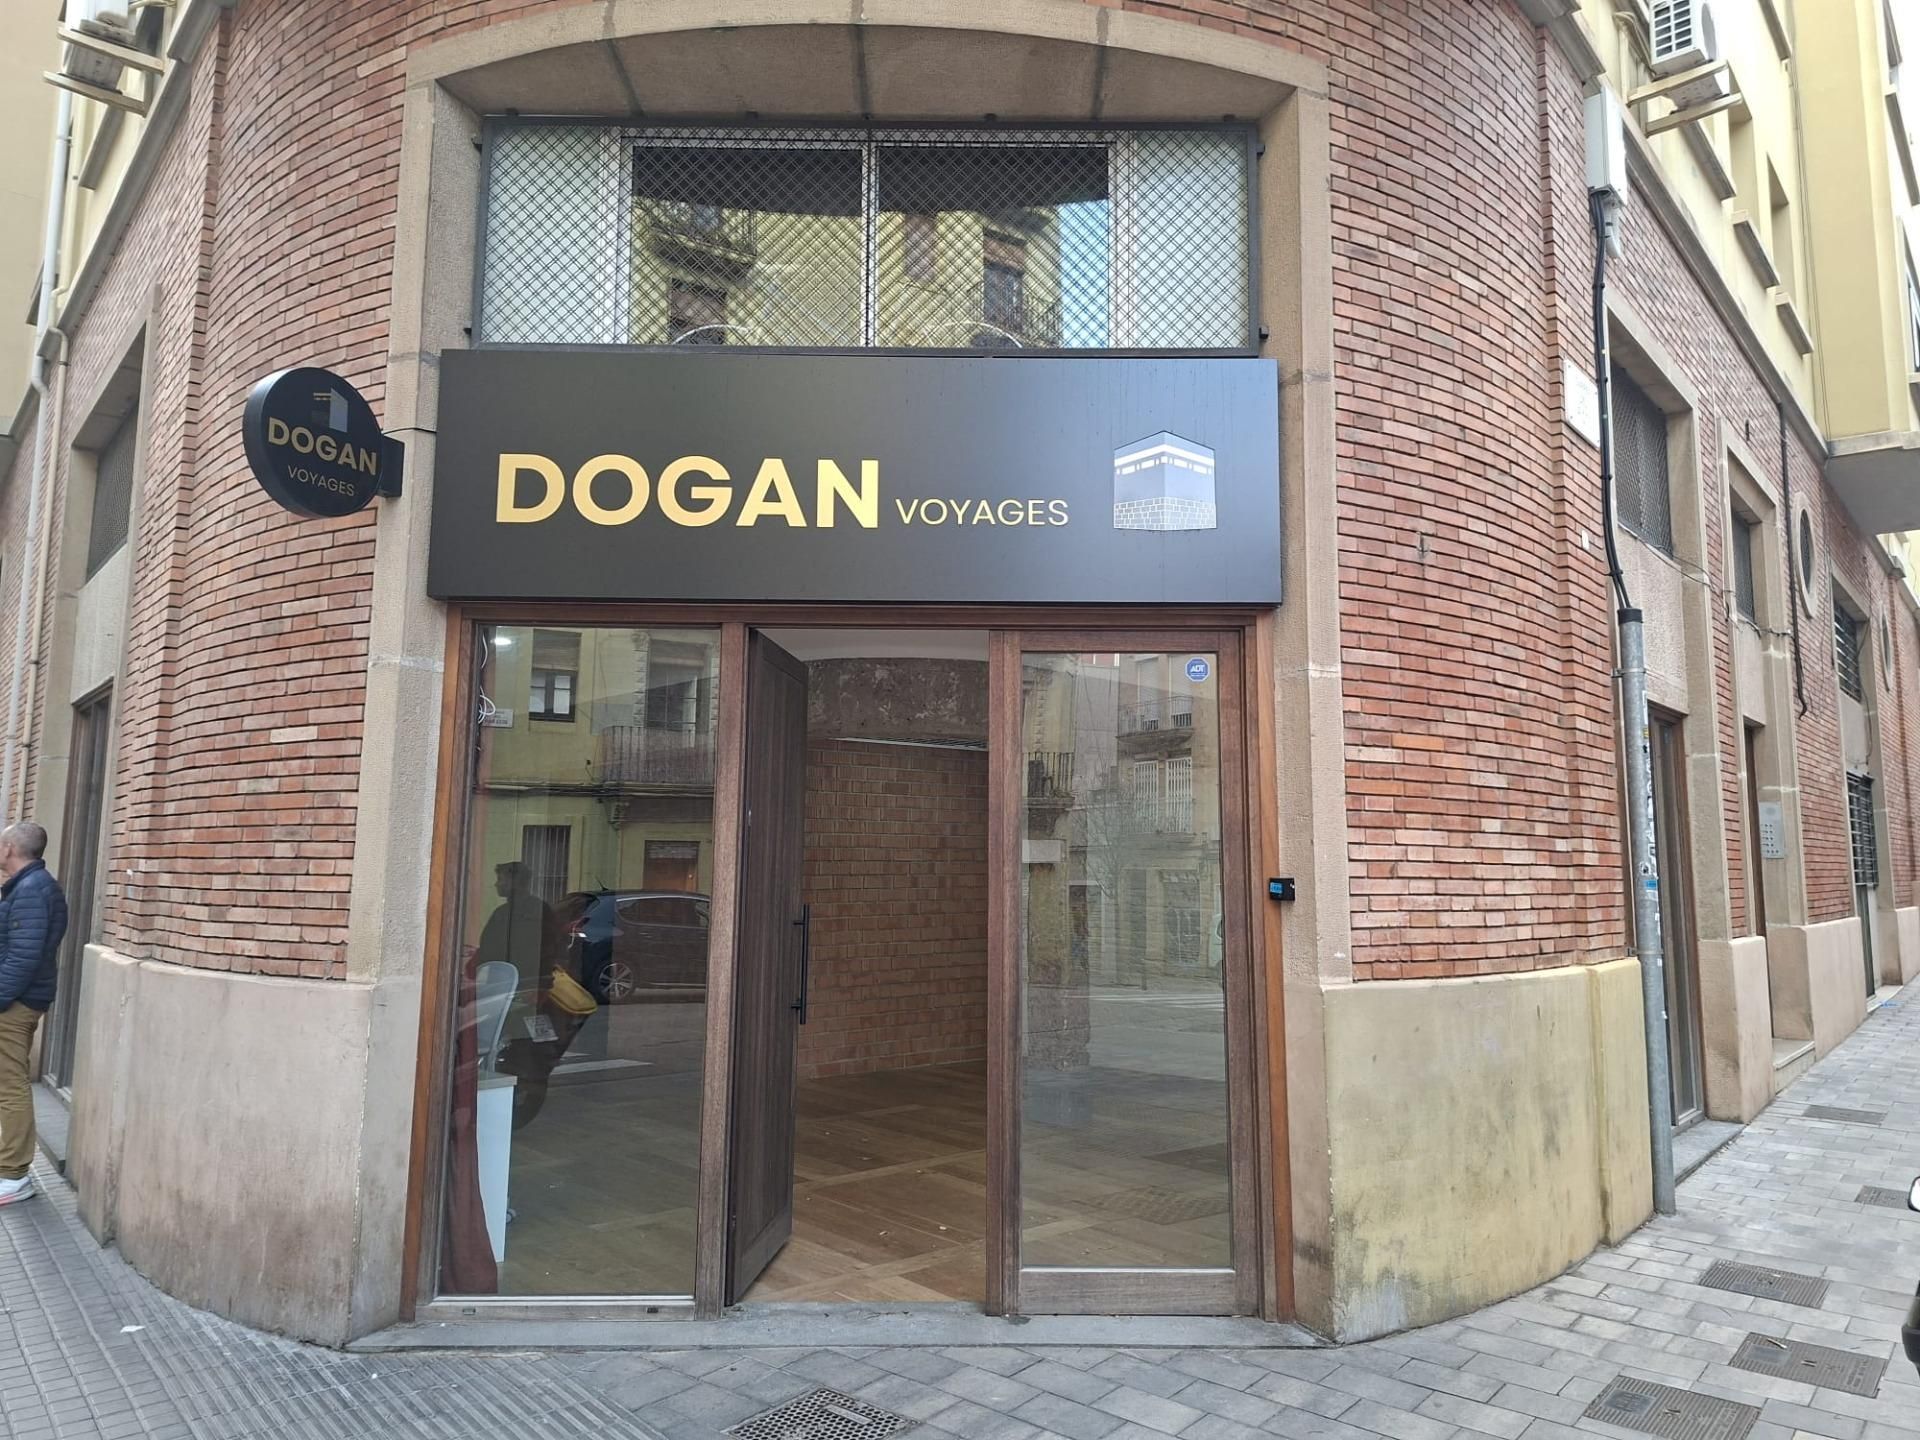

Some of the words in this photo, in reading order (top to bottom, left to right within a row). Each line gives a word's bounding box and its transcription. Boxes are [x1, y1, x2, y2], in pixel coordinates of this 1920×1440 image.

[268, 416, 377, 476] DOGAN
[287, 464, 355, 497] VOYAGES
[495, 453, 880, 529] DOGAN
[895, 498, 1069, 527] VOYAGES
[1190, 664, 1205, 672] ADT
